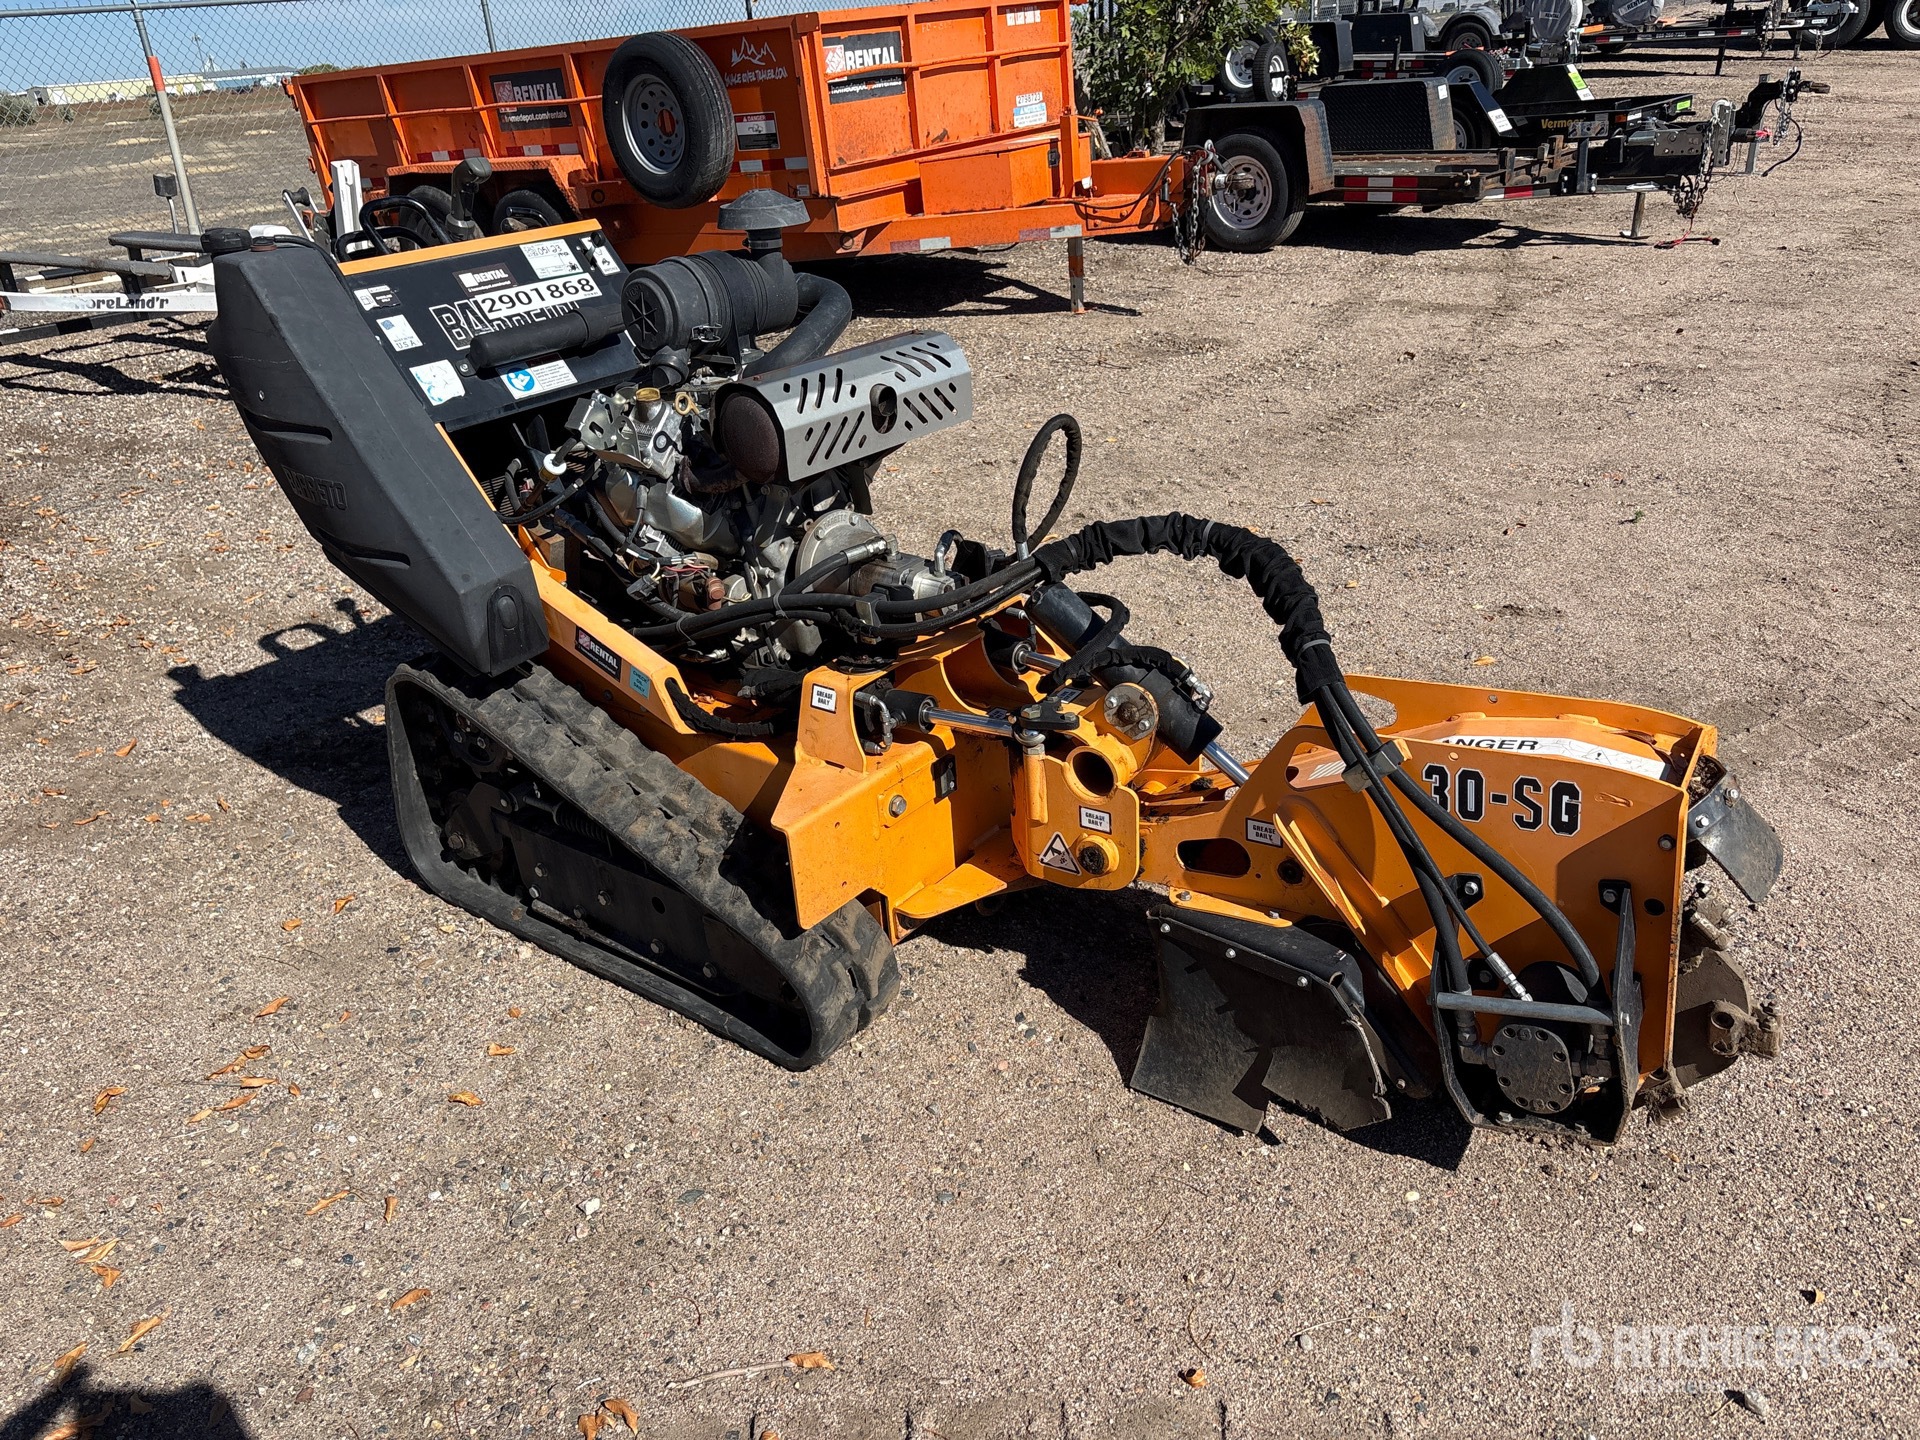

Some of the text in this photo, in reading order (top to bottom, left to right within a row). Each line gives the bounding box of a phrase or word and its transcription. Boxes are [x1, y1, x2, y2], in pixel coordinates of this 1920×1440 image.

[844, 46, 899, 71] RENTAL
[513, 82, 562, 103] RENTAL
[473, 269, 509, 283] RENTAL
[86, 296, 169, 310] oreLand'r
[481, 278, 595, 314] 2901868
[590, 640, 619, 669] RENTAL
[632, 670, 649, 684] CHECK
[816, 690, 833, 701] GREASE
[817, 697, 830, 706] DAILY
[1442, 739, 1539, 751] NGER
[1422, 763, 1582, 837] 30-SG
[1085, 811, 1105, 822] GREASE
[1088, 818, 1103, 828] DAILY
[1252, 824, 1276, 835] GREASE
[1255, 831, 1273, 842] DAILY
